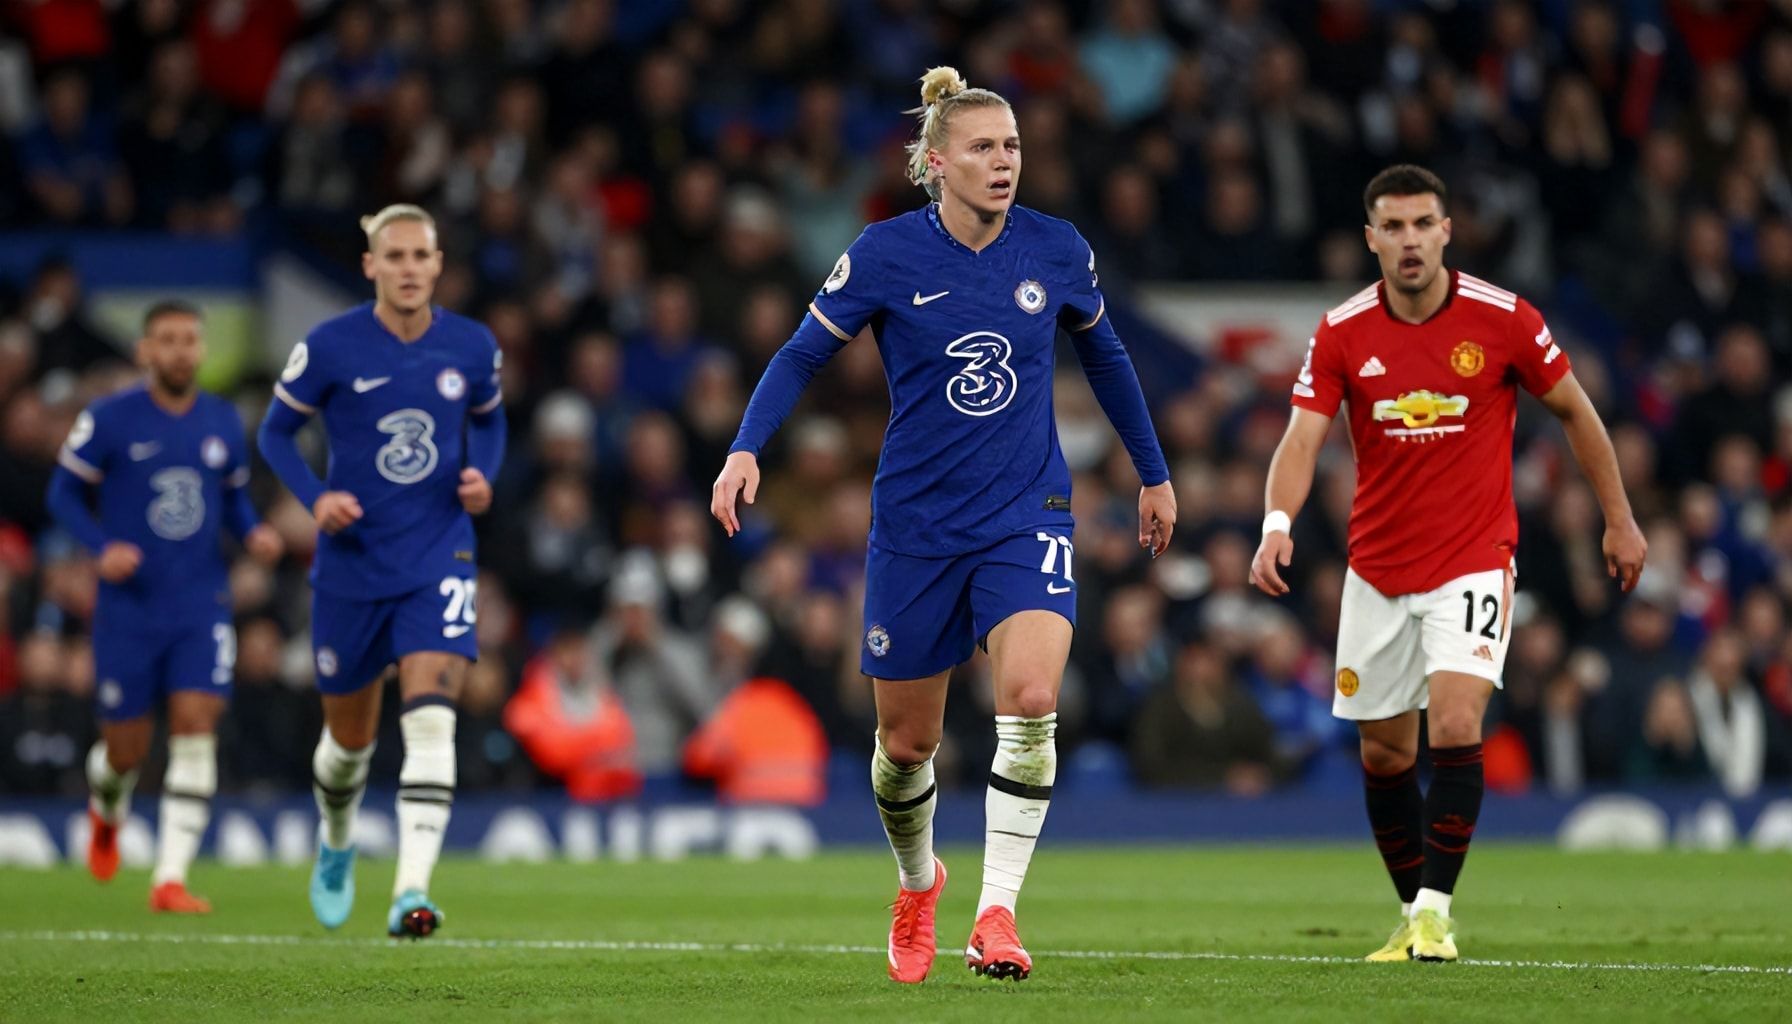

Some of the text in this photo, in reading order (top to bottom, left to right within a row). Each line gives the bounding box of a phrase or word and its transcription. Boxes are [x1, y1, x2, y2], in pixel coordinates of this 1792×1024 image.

[945, 331, 1017, 417] 3
[375, 408, 439, 485] 3
[1463, 590, 1499, 640] 12
